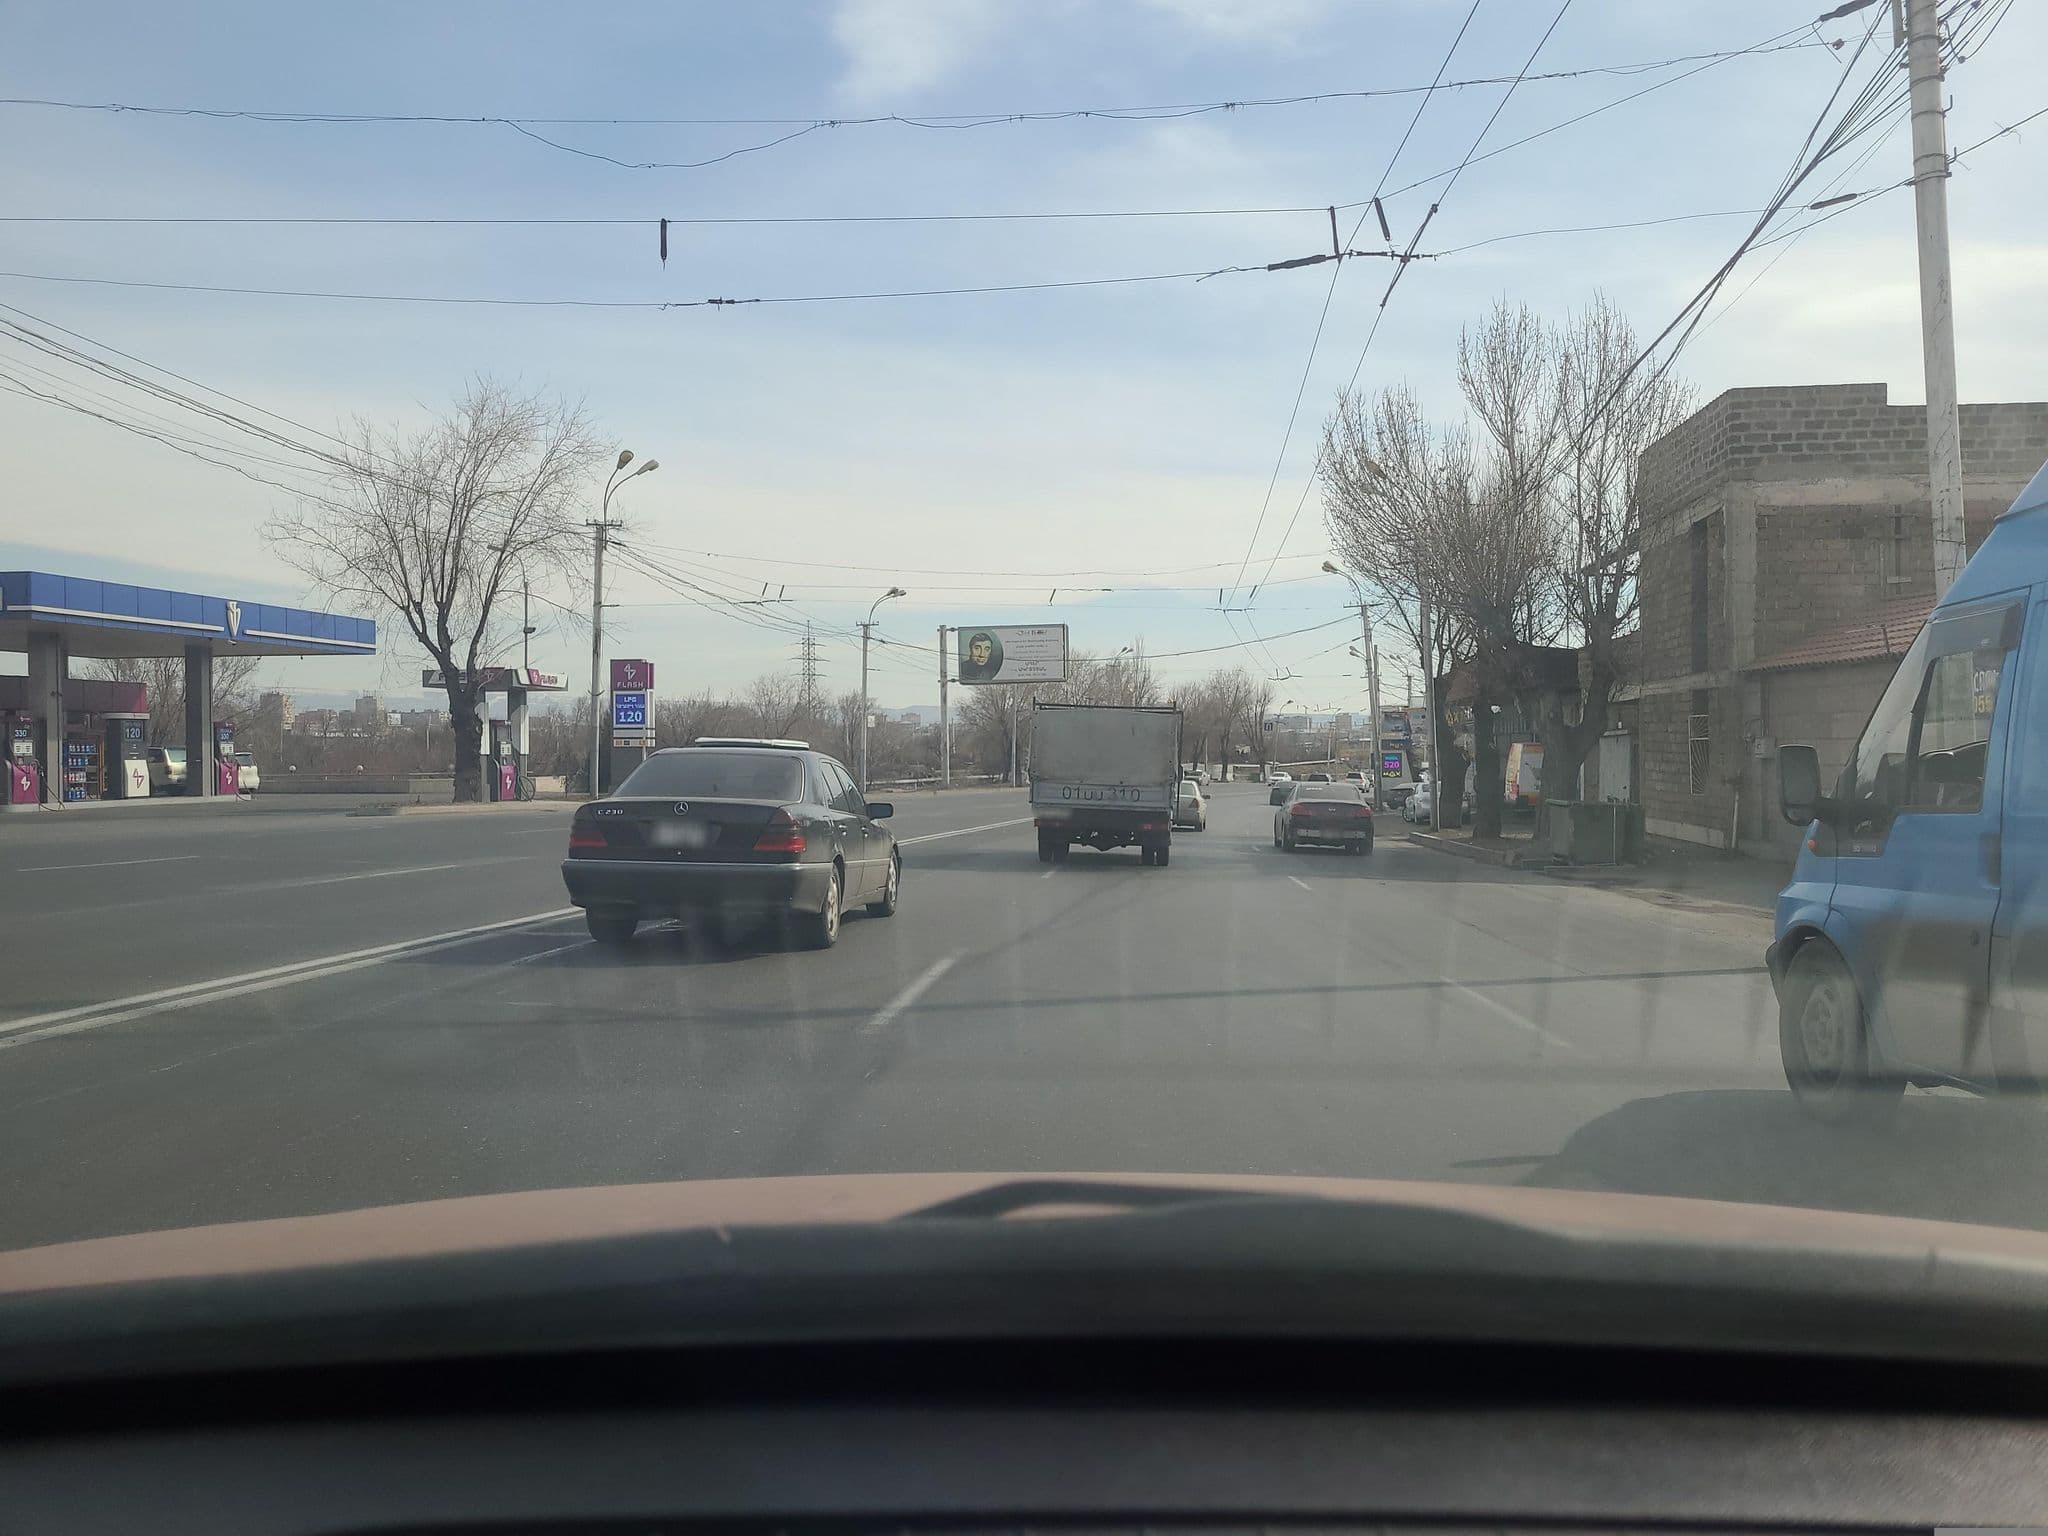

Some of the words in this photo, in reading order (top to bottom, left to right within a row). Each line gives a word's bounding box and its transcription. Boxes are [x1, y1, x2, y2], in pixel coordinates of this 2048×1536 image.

[616, 681, 644, 689] FLASH
[619, 711, 643, 722] 120
[126, 727, 141, 738] 120
[1384, 761, 1400, 769] 520
